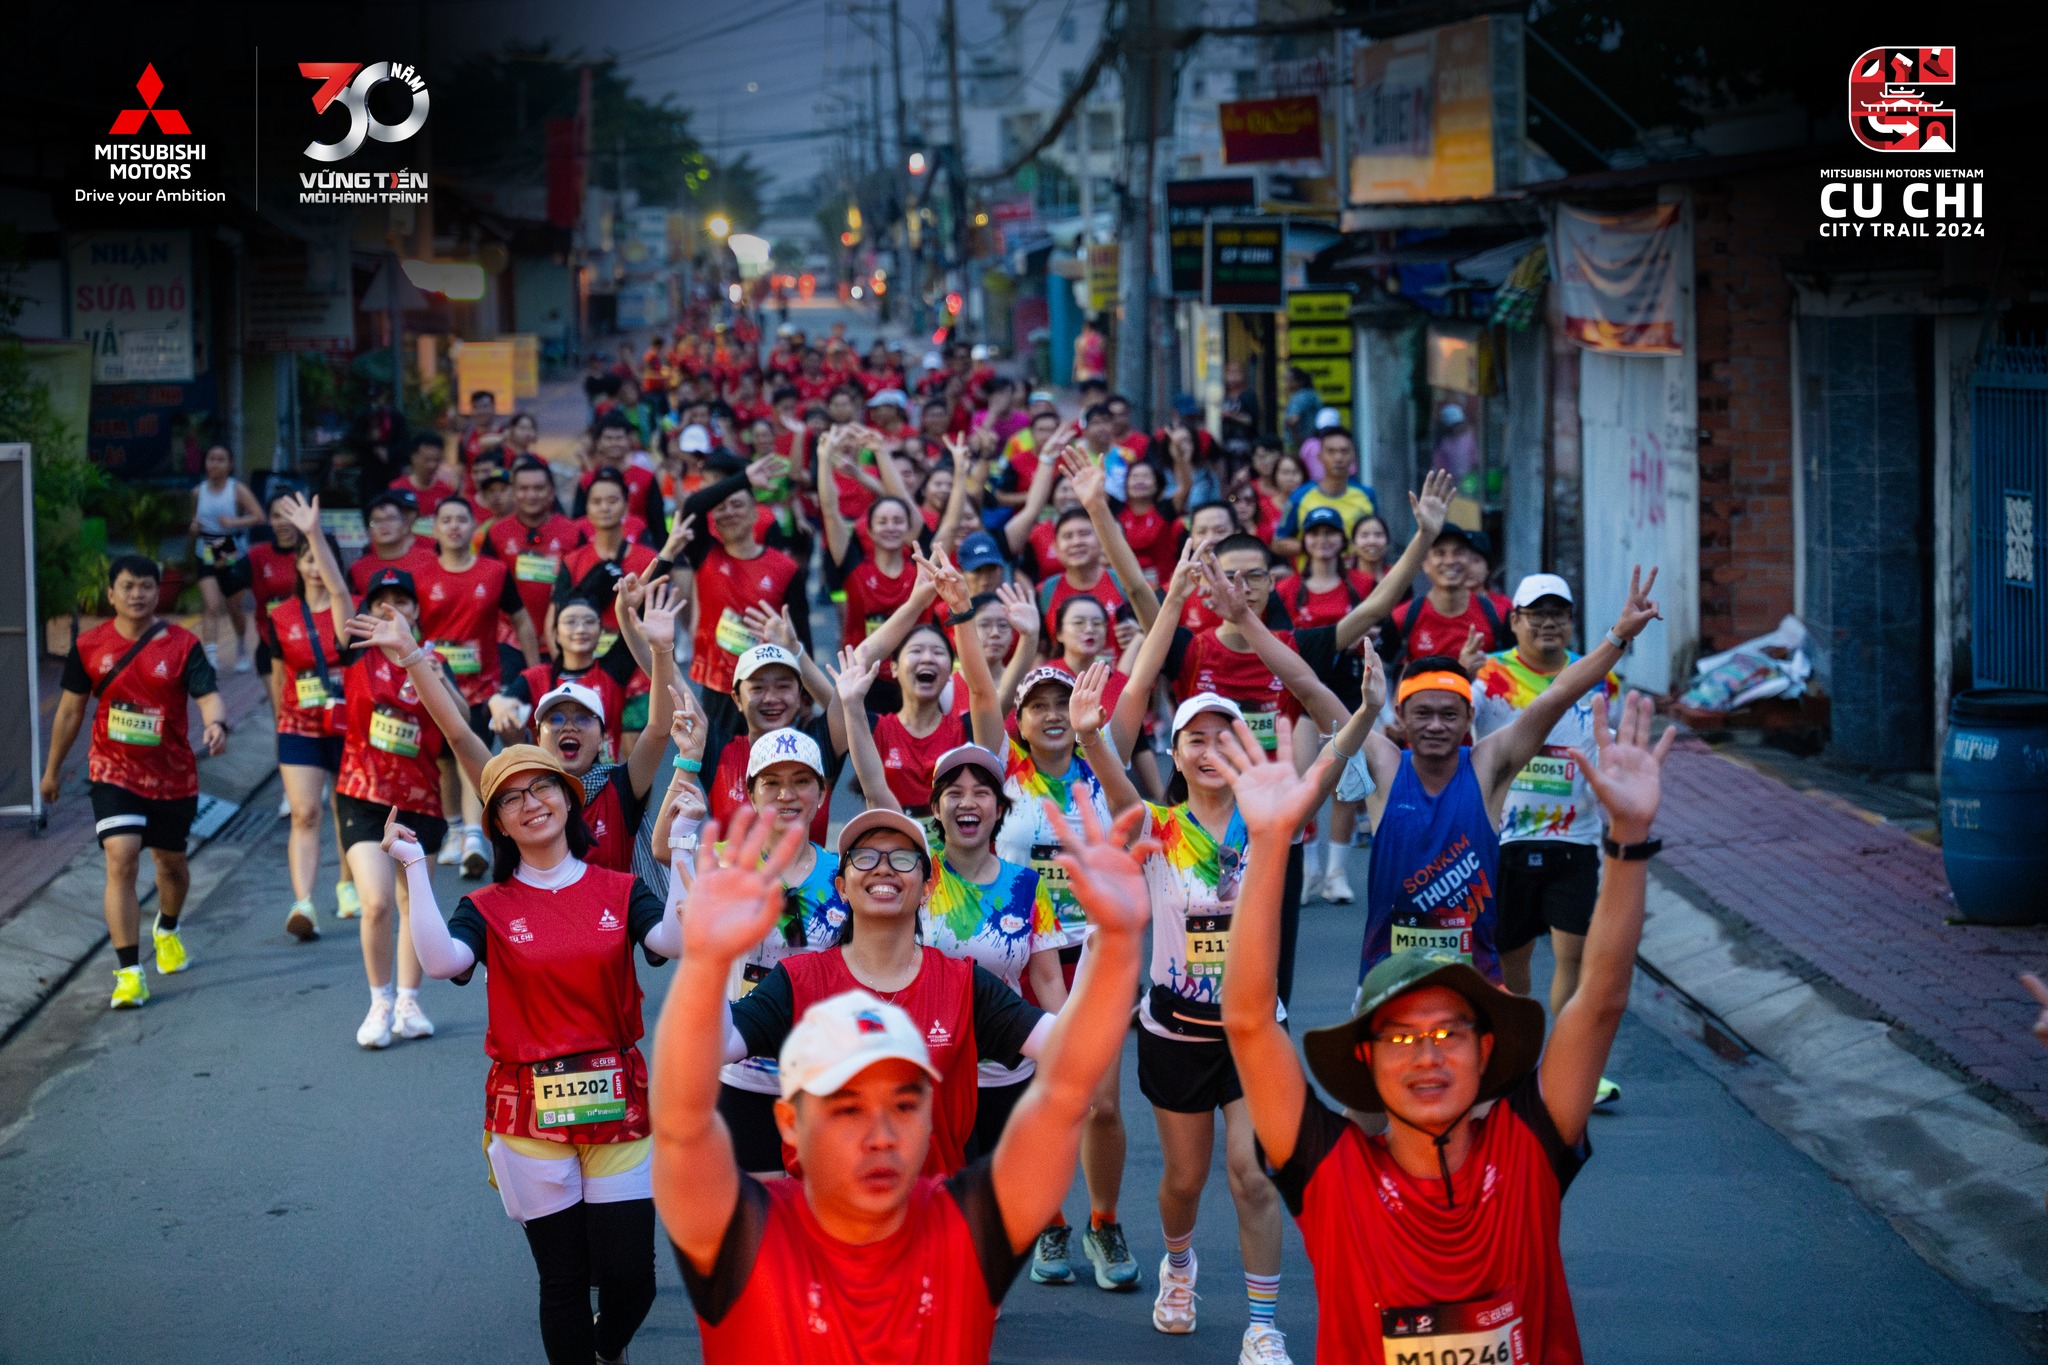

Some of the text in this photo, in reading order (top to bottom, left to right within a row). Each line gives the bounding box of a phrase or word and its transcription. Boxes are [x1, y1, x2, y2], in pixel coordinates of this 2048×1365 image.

[755, 646, 781, 655] OAT
[755, 653, 785, 661] MILK
[1402, 833, 1471, 894] SONKIM
[1412, 851, 1480, 912] THUDUC
[1447, 885, 1469, 908] CITY
[1396, 934, 1459, 949] M10130
[543, 1078, 609, 1100] F11202
[1396, 1340, 1509, 1365] M10246
